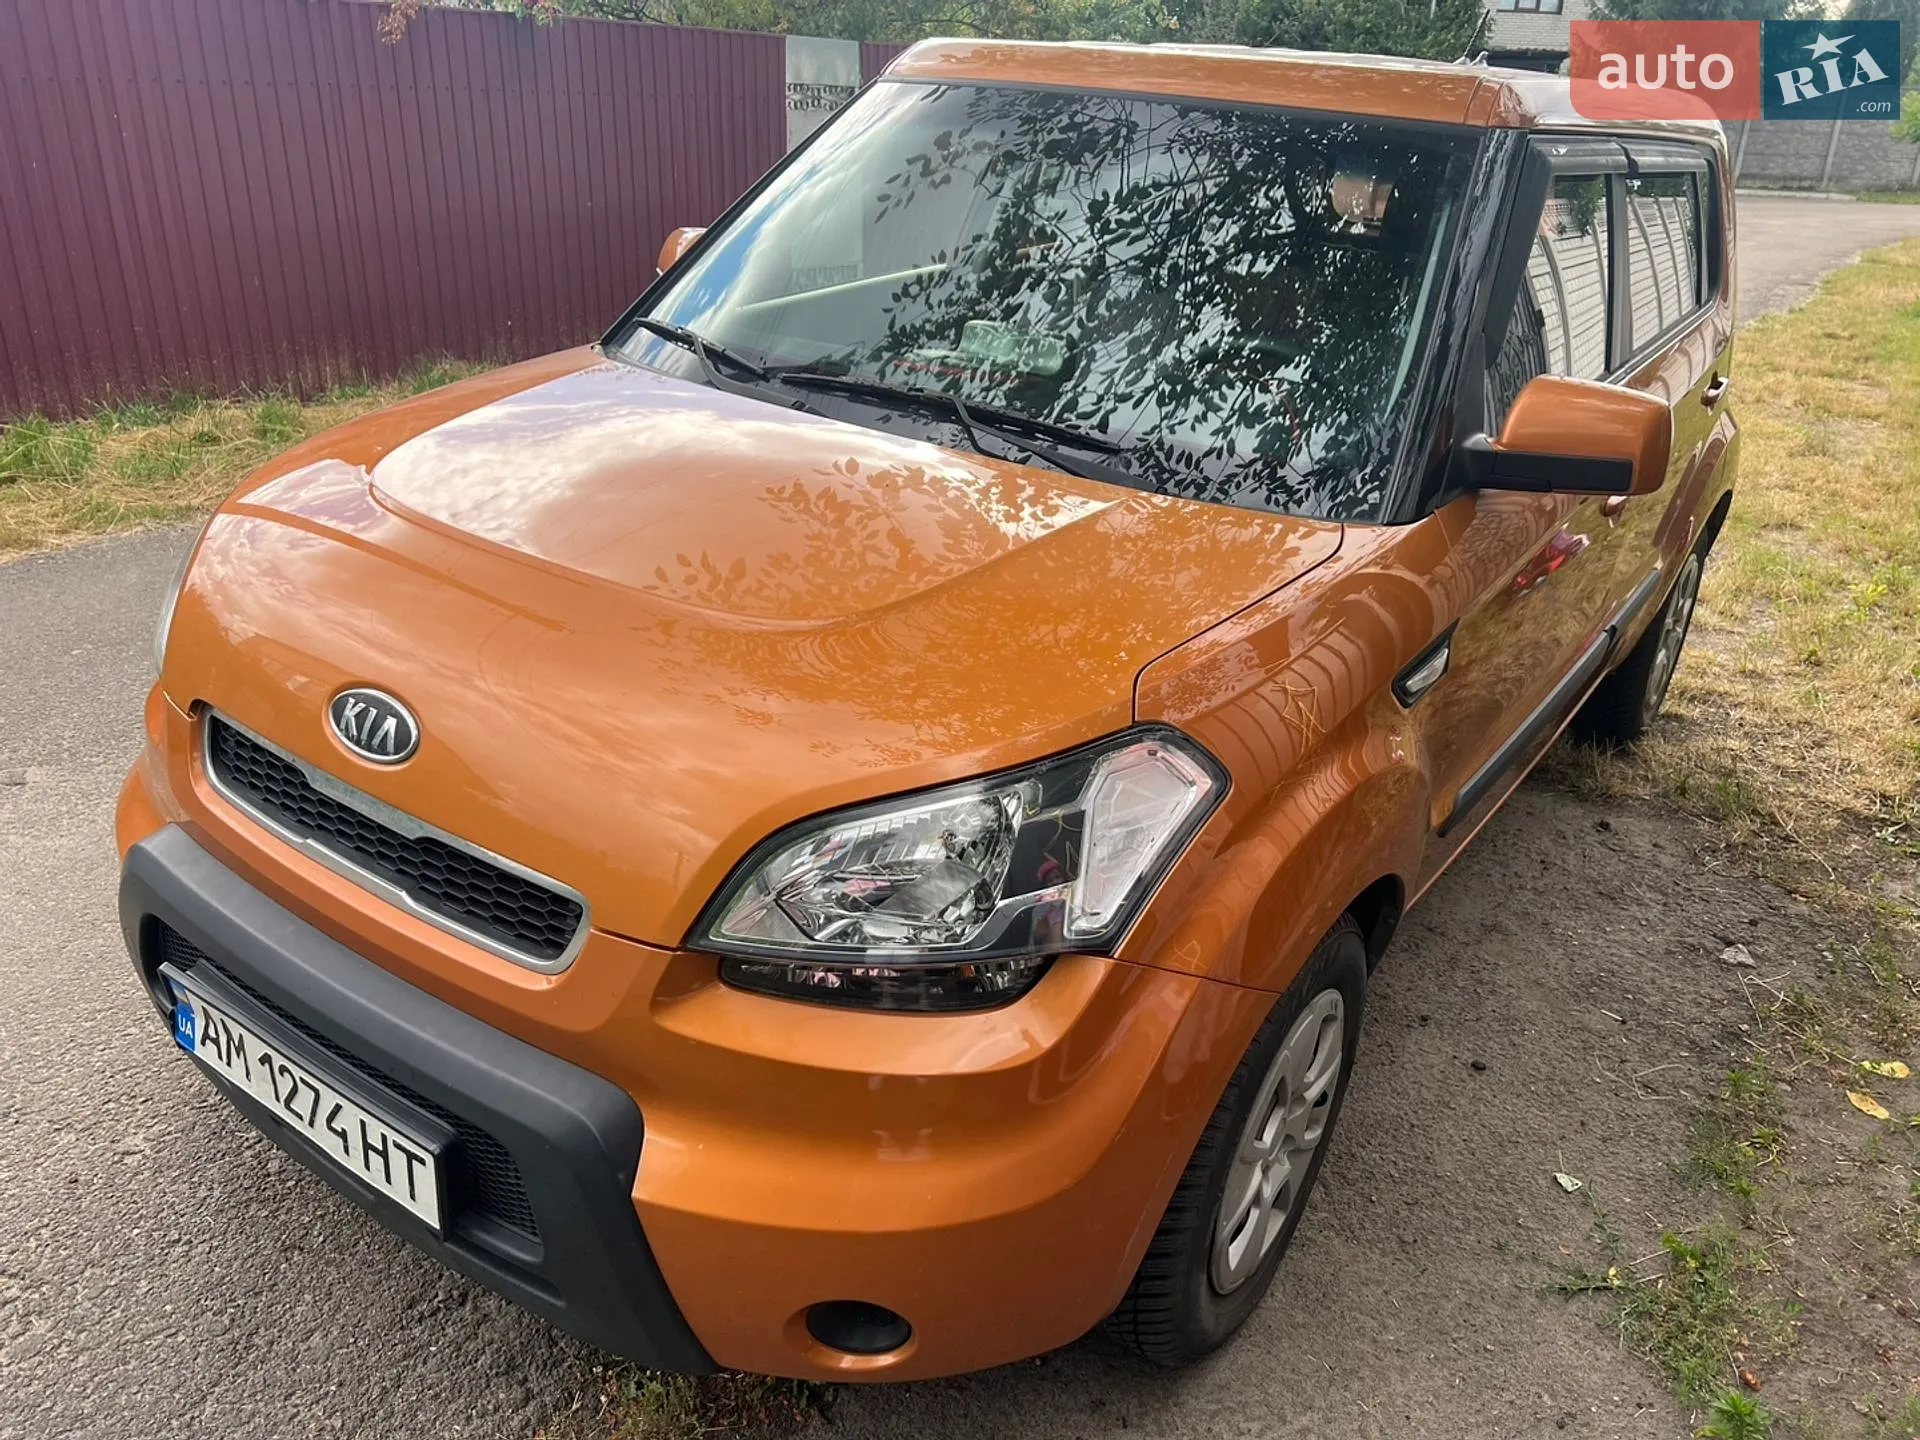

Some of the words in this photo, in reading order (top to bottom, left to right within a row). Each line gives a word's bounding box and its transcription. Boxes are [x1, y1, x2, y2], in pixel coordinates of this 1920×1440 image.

[340, 697, 397, 756] KIA
[178, 1015, 194, 1039] UA
[200, 1005, 251, 1082] AM
[258, 1052, 349, 1157] 1274
[359, 1118, 426, 1202] HT
